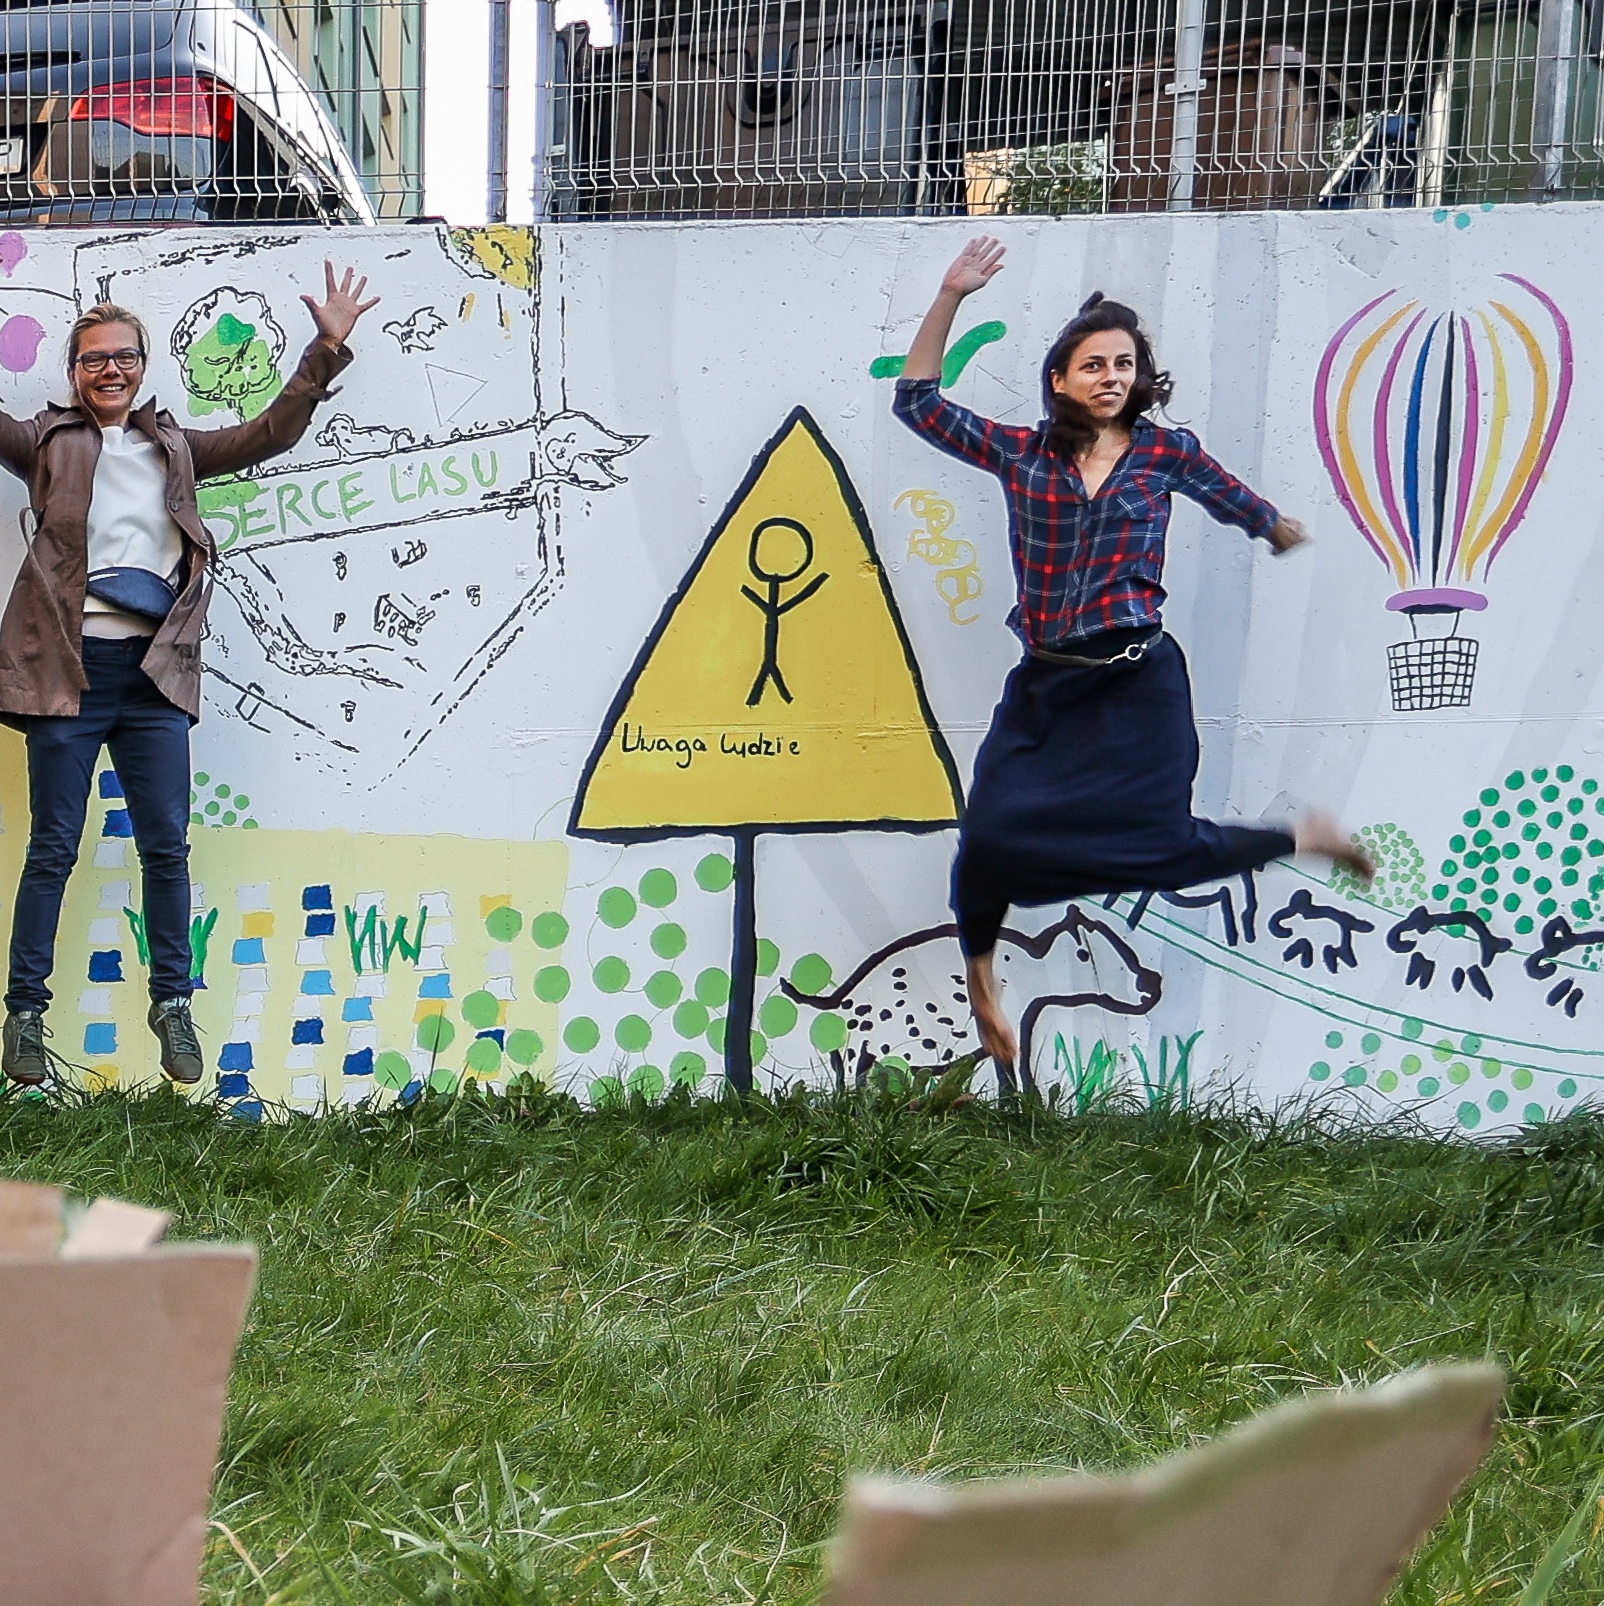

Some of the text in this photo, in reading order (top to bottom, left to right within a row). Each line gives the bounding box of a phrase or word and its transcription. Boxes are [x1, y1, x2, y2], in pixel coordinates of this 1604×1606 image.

[198, 450, 499, 551] SERCE LASU
[622, 722, 801, 769] Uwaga ludzie
